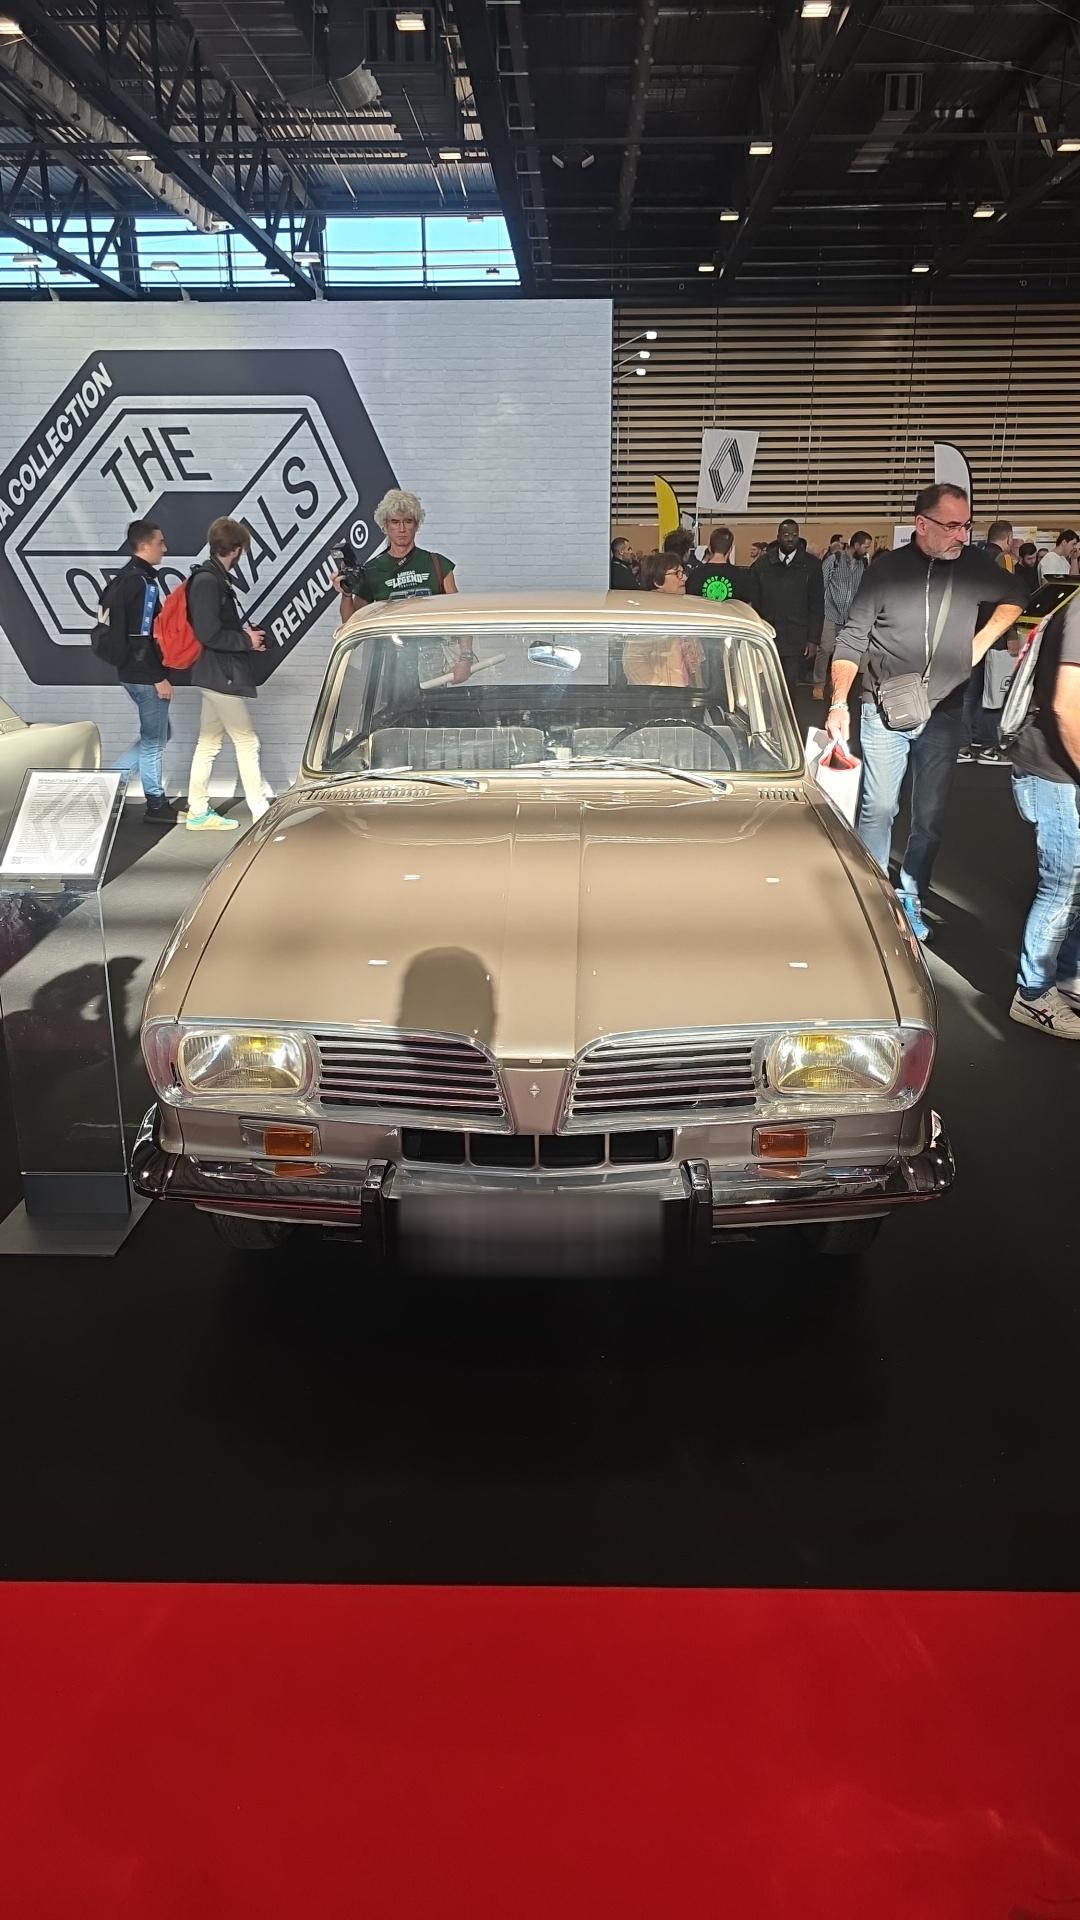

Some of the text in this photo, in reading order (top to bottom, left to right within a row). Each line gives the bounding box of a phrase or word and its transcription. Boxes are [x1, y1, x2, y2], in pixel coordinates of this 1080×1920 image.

[8, 362, 113, 505] COLLECTION
[101, 426, 213, 513] THE
[270, 538, 347, 647] RENAU
[392, 573, 423, 589] LEGEND
